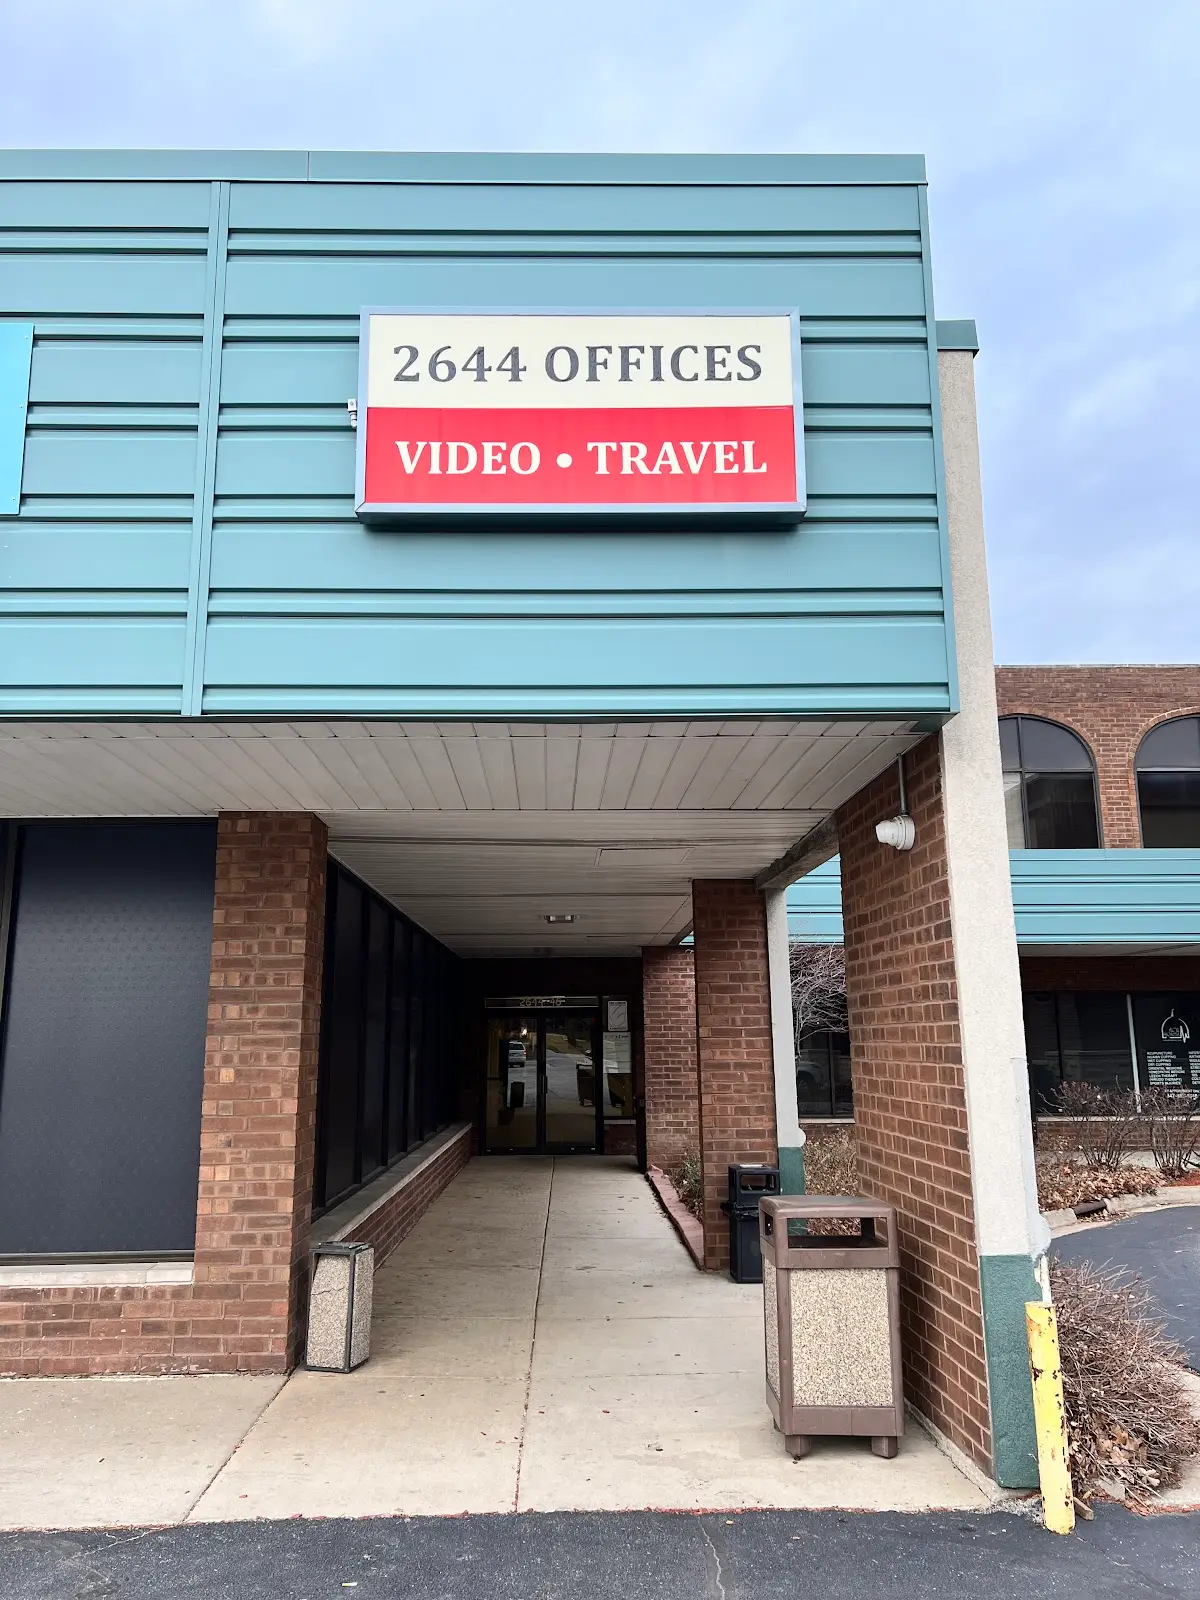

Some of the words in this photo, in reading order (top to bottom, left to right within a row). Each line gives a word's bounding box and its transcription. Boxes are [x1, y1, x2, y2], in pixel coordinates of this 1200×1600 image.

[393, 345, 527, 382] 2644
[544, 344, 763, 382] OFFICES
[395, 441, 541, 475] VIDEO
[587, 440, 768, 475] TRAVEL
